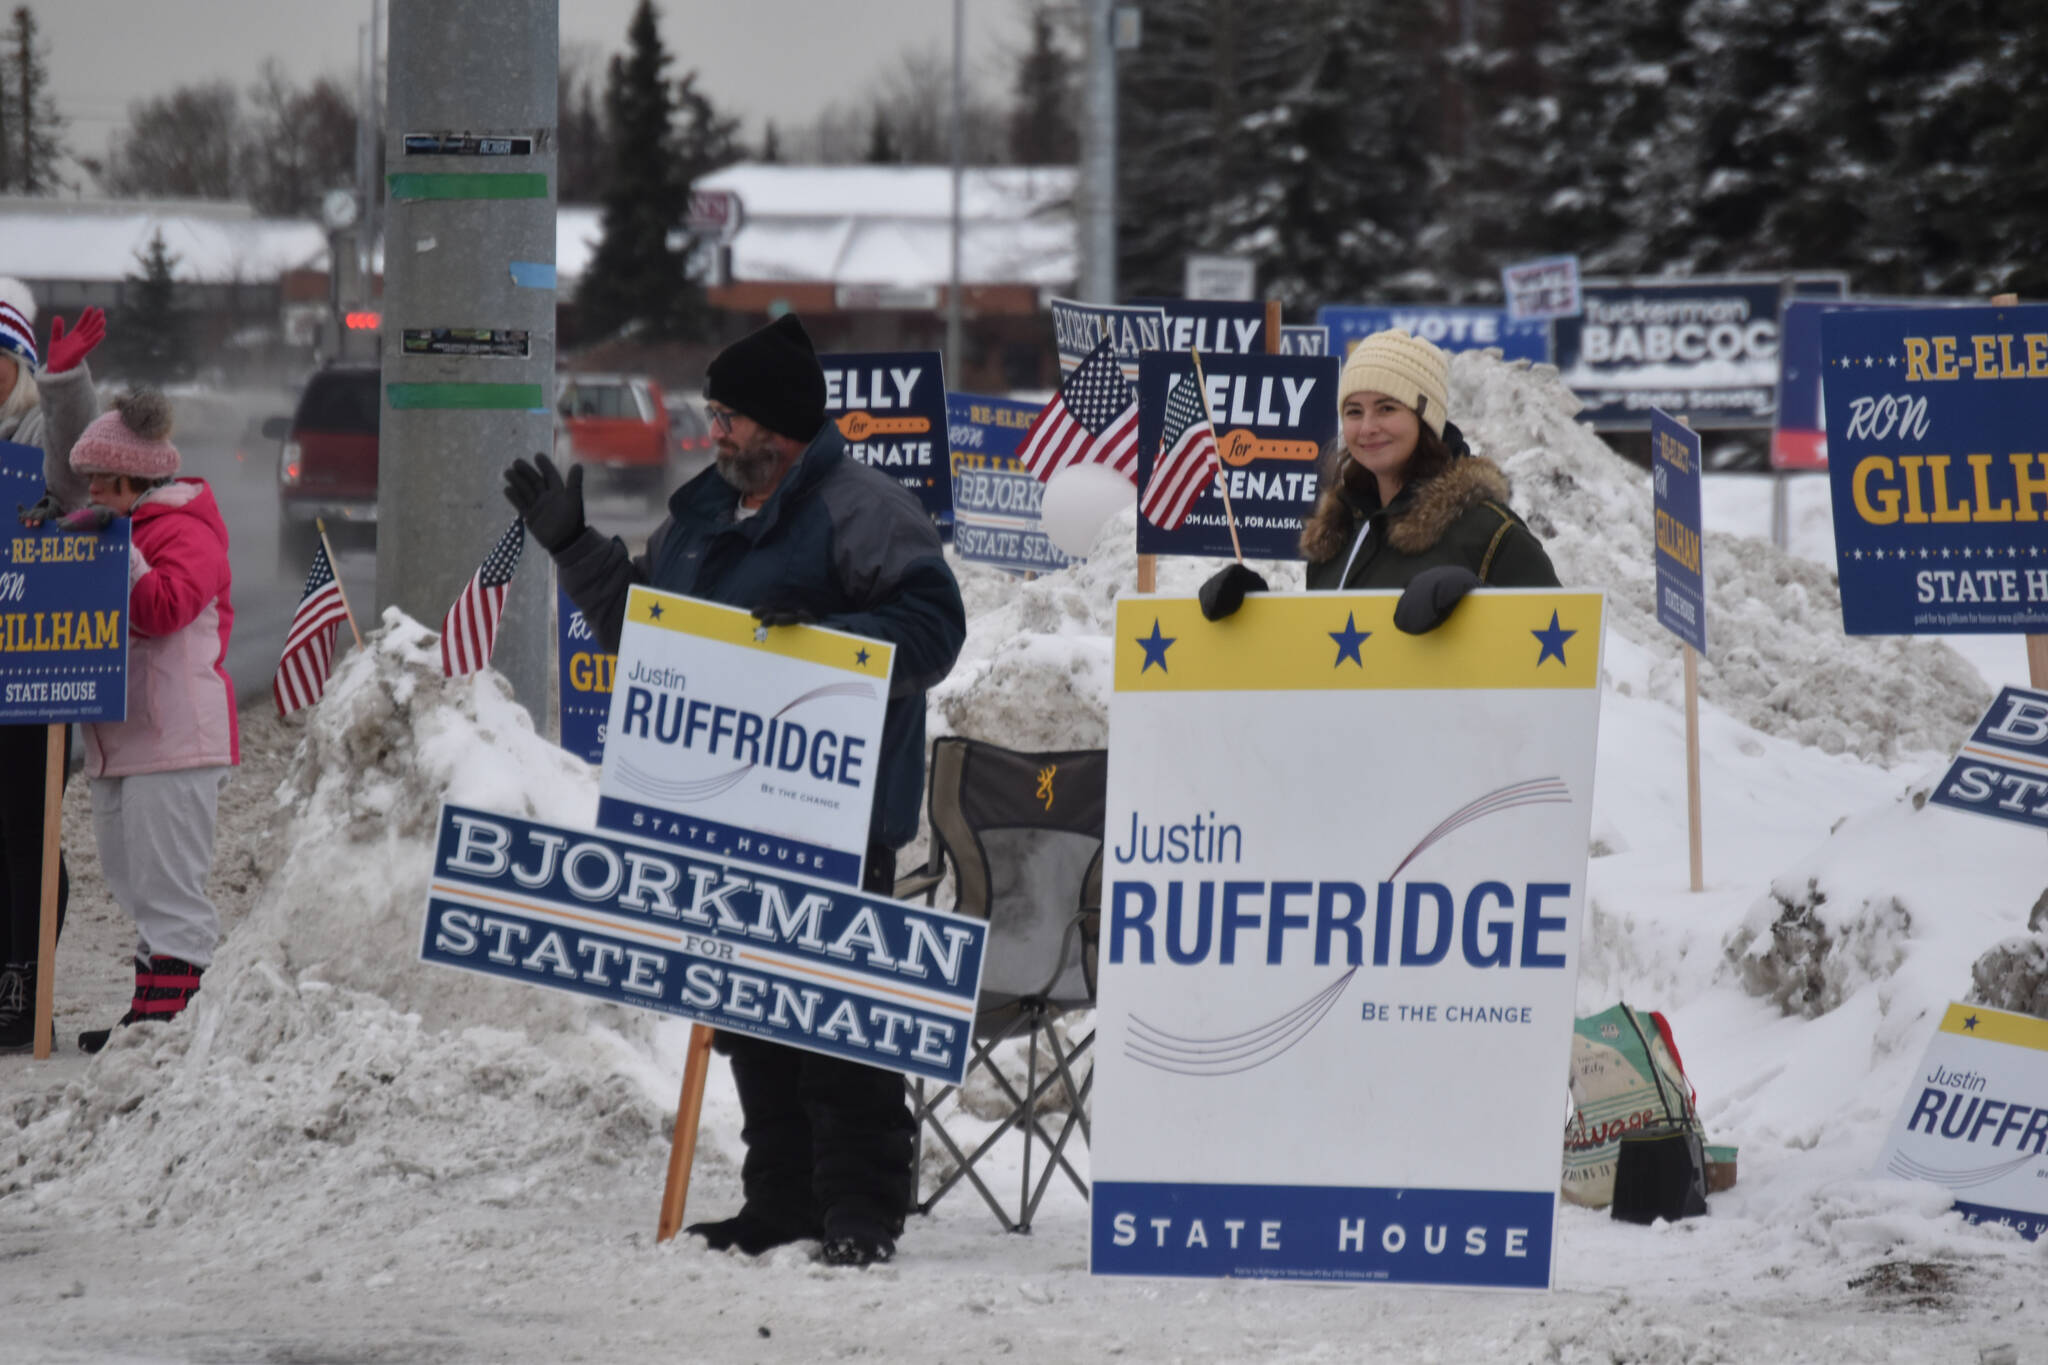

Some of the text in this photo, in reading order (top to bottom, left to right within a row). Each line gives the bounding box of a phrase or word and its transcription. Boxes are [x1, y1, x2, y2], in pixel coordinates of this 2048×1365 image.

[1391, 313, 1499, 343] VOTE
[848, 415, 868, 434] for
[1846, 394, 1931, 441] RON
[1229, 434, 1251, 458] for
[1213, 471, 1318, 502] SENATE
[1244, 517, 1264, 529] FOR
[1265, 517, 1303, 530] ALASKA
[11, 535, 98, 563] RE-ELECT
[1656, 507, 1701, 577] GILLHAM
[1916, 569, 2020, 603] STATE
[628, 660, 686, 691] Justin
[5, 680, 96, 703] STATE HOUSE
[622, 686, 867, 788] RUFFRIDGE
[633, 812, 718, 844] STATE
[738, 837, 825, 869] HOUSE
[1114, 811, 1242, 864] Justin
[447, 814, 973, 986] BJORKMAN
[1108, 880, 1571, 969] RUFFRIDGE
[683, 936, 735, 960] FOR
[436, 908, 958, 1068] STATE SENATE
[1397, 1005, 1438, 1023] THE
[1445, 1006, 1533, 1024] CHANGE
[1927, 1065, 1987, 1092] Justin
[1112, 1211, 1529, 1258] STATE HOUSE
